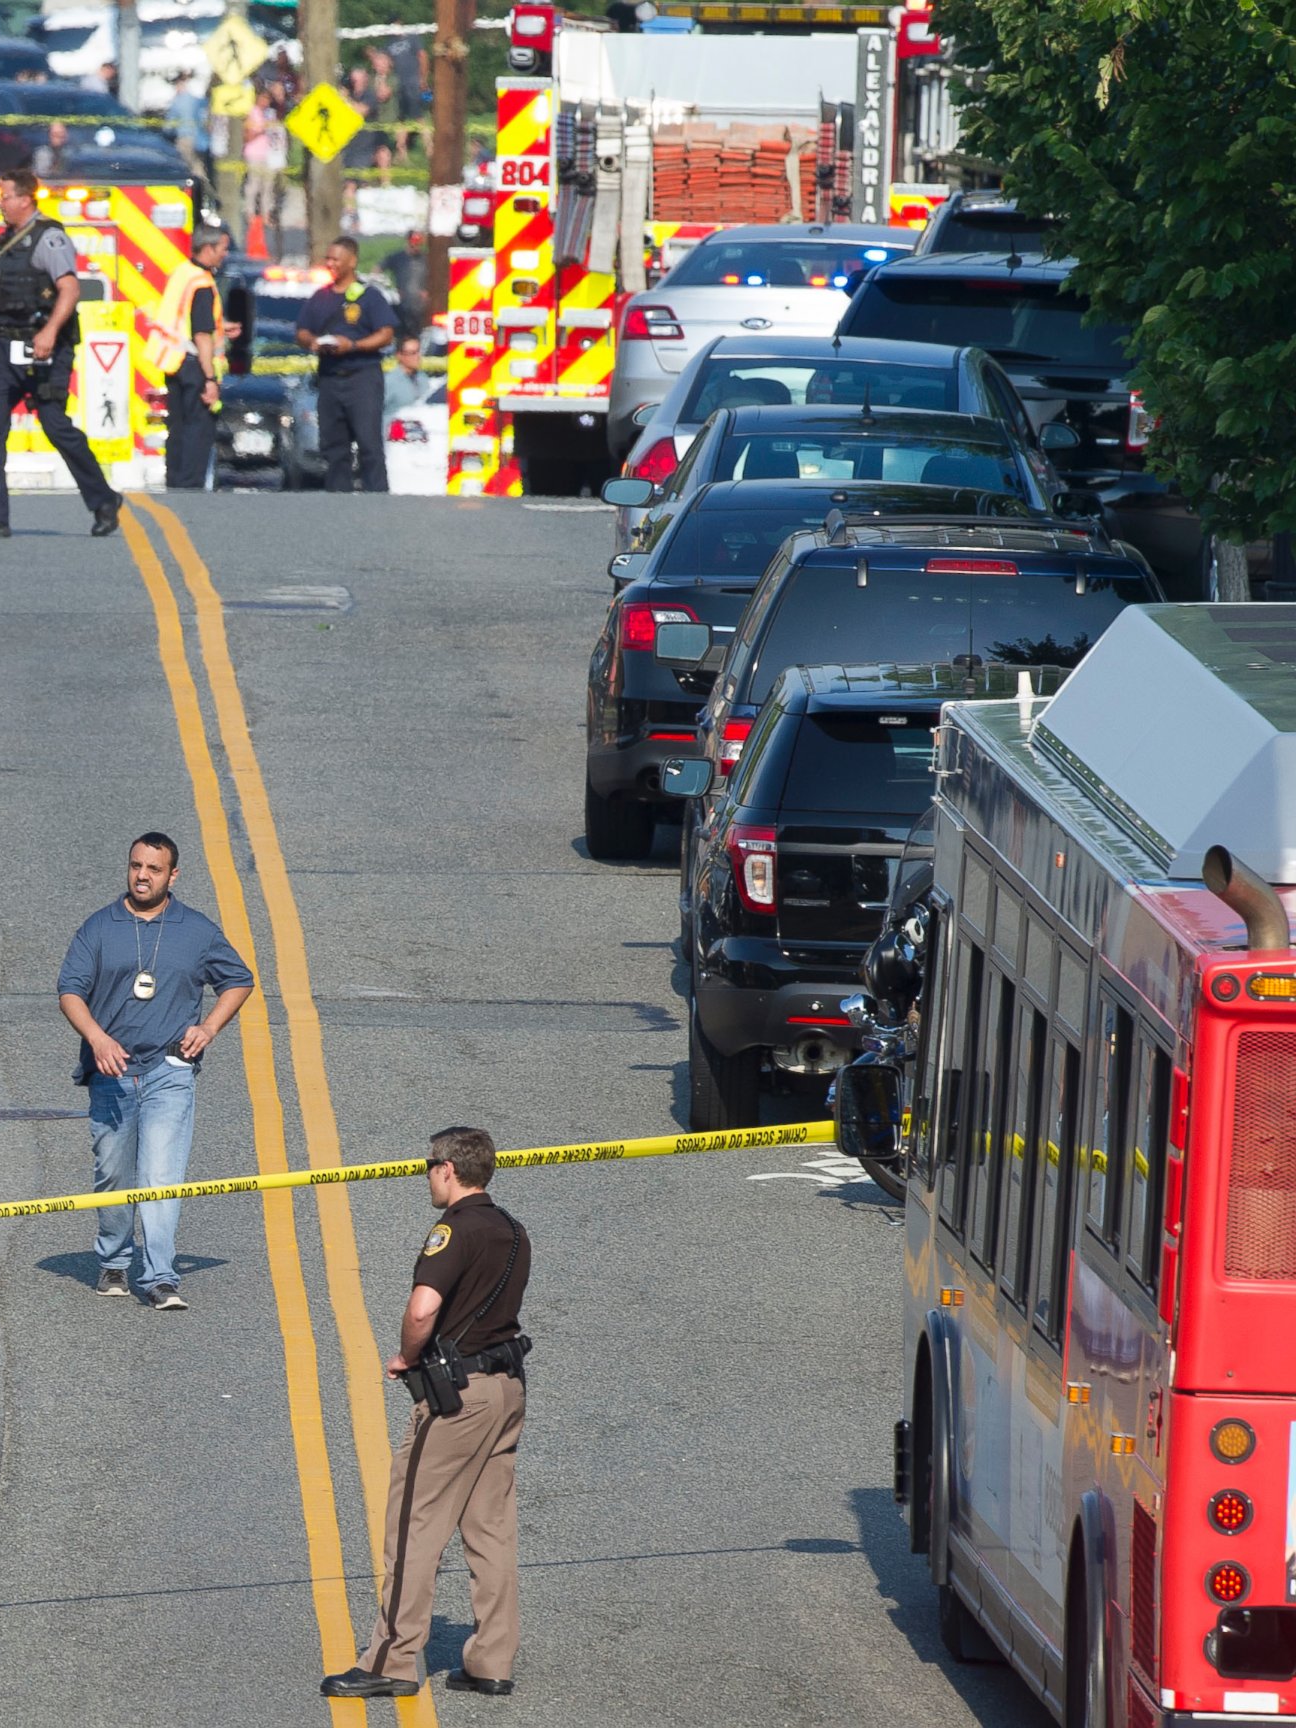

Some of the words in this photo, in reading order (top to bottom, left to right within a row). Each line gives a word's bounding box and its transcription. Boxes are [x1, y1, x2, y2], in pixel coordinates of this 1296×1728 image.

[861, 34, 883, 224] ALEXANDRIA
[728, 1135, 743, 1148] DO
[746, 1131, 775, 1147] SCENE
[776, 1126, 808, 1142] CRIME
[674, 1138, 706, 1153] CROSS
[707, 1136, 726, 1151] NOT
